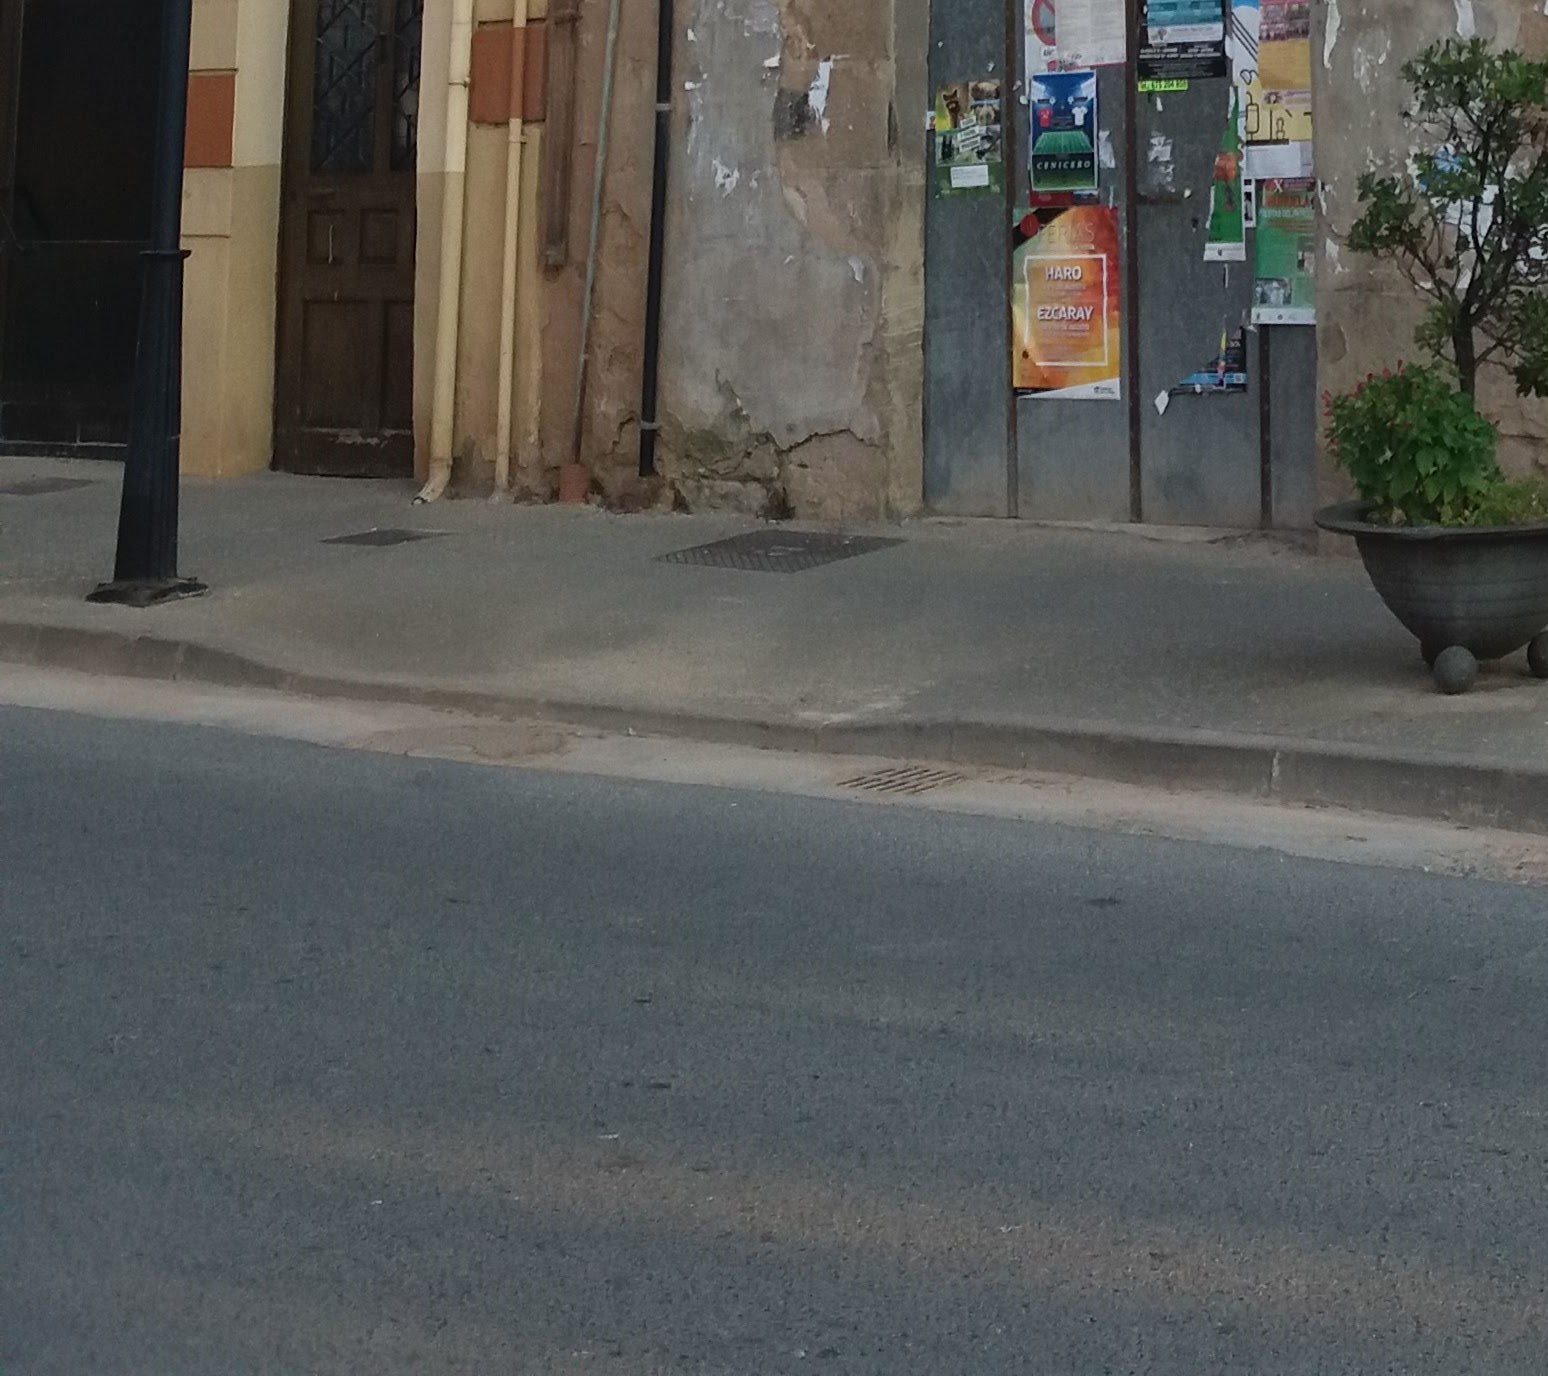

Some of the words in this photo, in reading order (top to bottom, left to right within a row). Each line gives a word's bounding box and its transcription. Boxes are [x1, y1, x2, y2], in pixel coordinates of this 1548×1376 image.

[1036, 160, 1092, 170] CENICERO
[1045, 265, 1083, 281] HARO
[1036, 305, 1094, 321] EZCARAY
